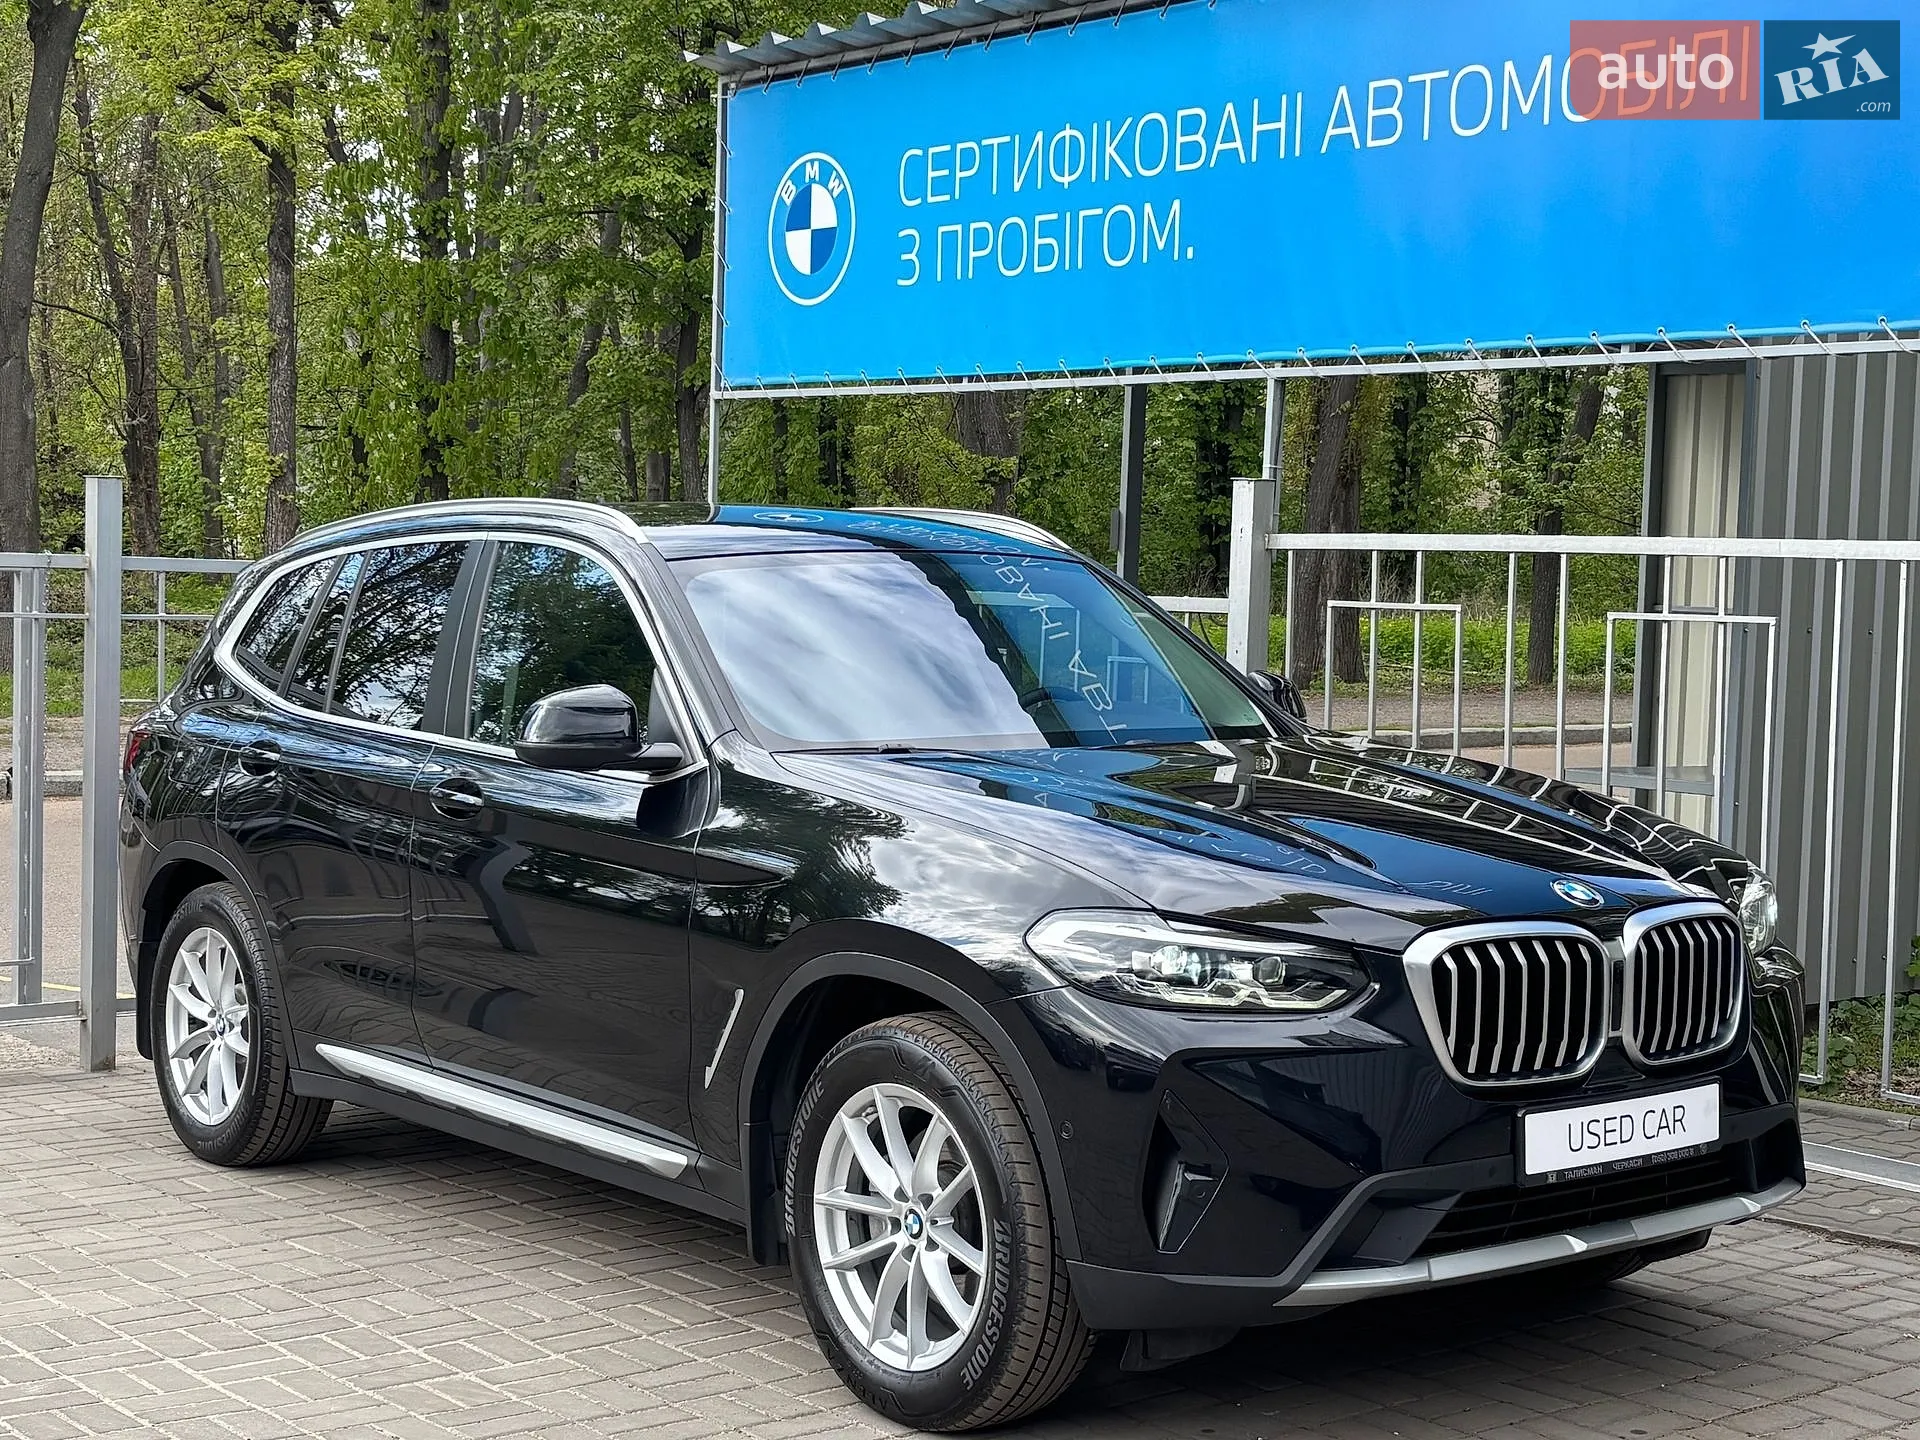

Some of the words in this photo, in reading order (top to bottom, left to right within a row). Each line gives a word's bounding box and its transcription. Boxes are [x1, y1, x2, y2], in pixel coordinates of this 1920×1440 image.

[780, 160, 845, 207] BMW
[897, 91, 1303, 208] СЕРТИФІКОВАНІ
[896, 228, 921, 287] З
[935, 199, 1195, 283] ПРОБІГОМ.
[785, 1078, 825, 1237] BRIDGESTONE
[1567, 1113, 1635, 1153] USED
[1642, 1104, 1687, 1140] CAR
[960, 1217, 1011, 1392] BRIDGESTONE
